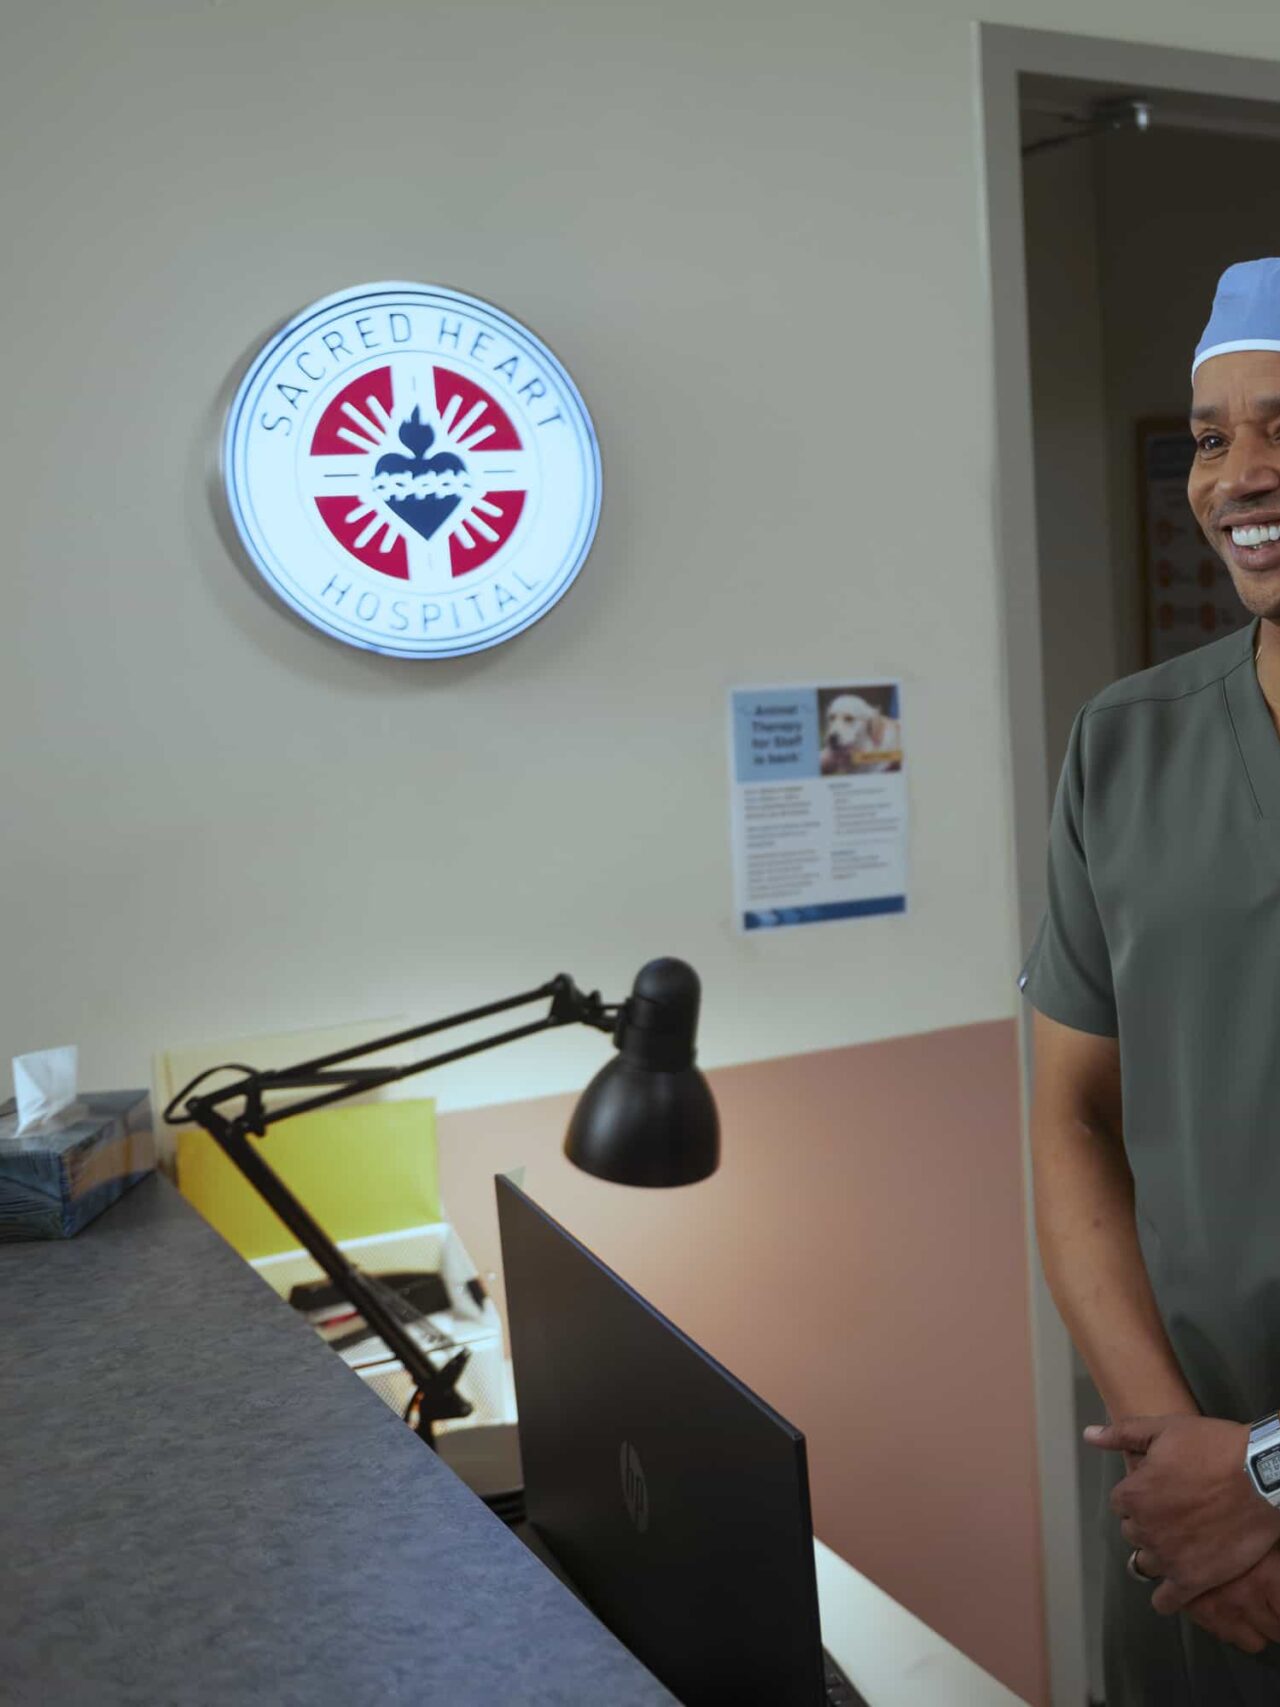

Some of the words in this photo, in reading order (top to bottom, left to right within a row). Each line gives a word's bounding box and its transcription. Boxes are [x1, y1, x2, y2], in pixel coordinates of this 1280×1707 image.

[261, 313, 412, 436] SACRED
[438, 316, 568, 428] HEART
[320, 573, 540, 633] HOSPITAL
